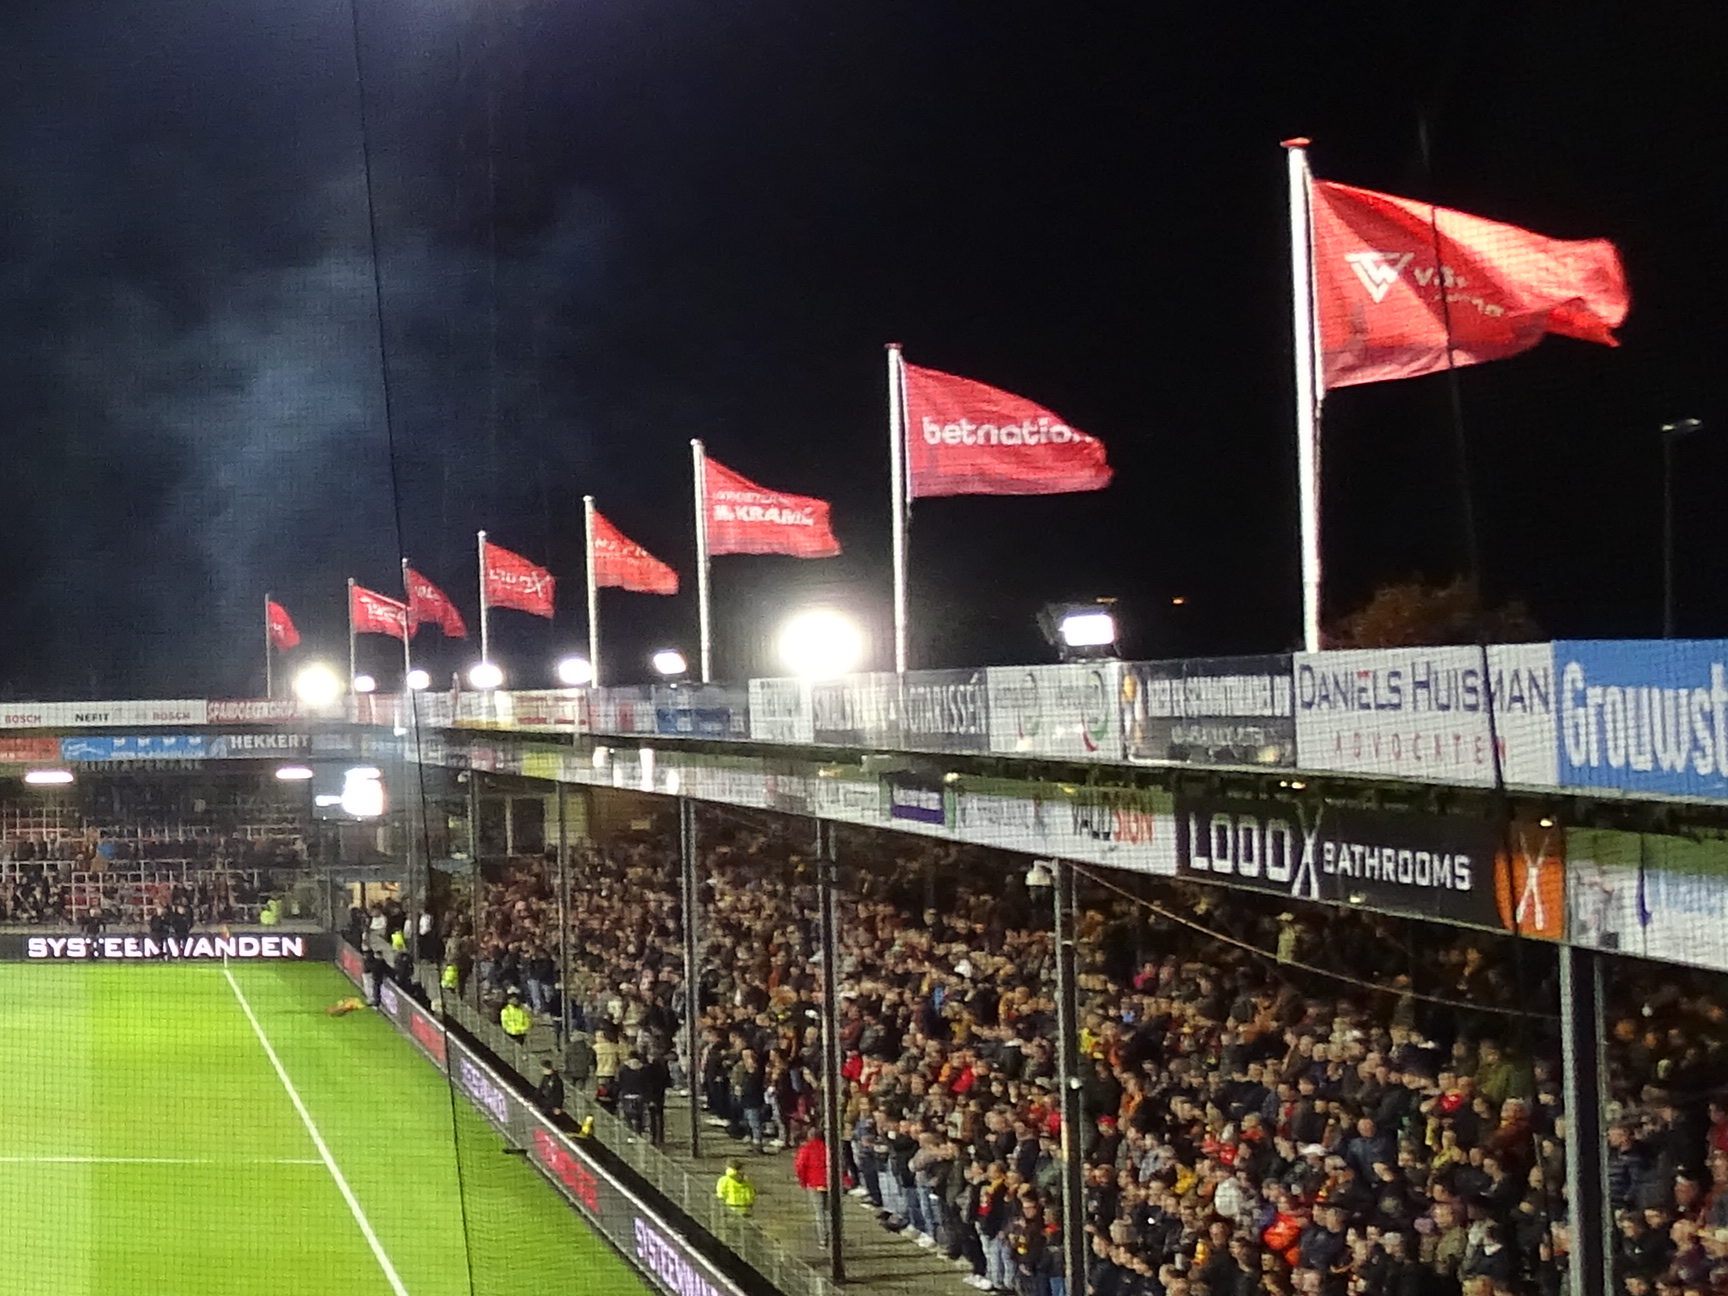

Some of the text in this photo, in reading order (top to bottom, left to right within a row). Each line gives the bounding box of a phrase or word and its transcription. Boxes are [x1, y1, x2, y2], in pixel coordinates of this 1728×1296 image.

[1299, 664, 1402, 711] DANIELS
[5, 714, 42, 724] BOSCH
[75, 713, 110, 723] NEFIT
[152, 711, 191, 721] BOSCH
[1562, 660, 1728, 778] Grouwst
[230, 734, 310, 750] HEKKERT
[1322, 841, 1472, 891] BATHROOMS
